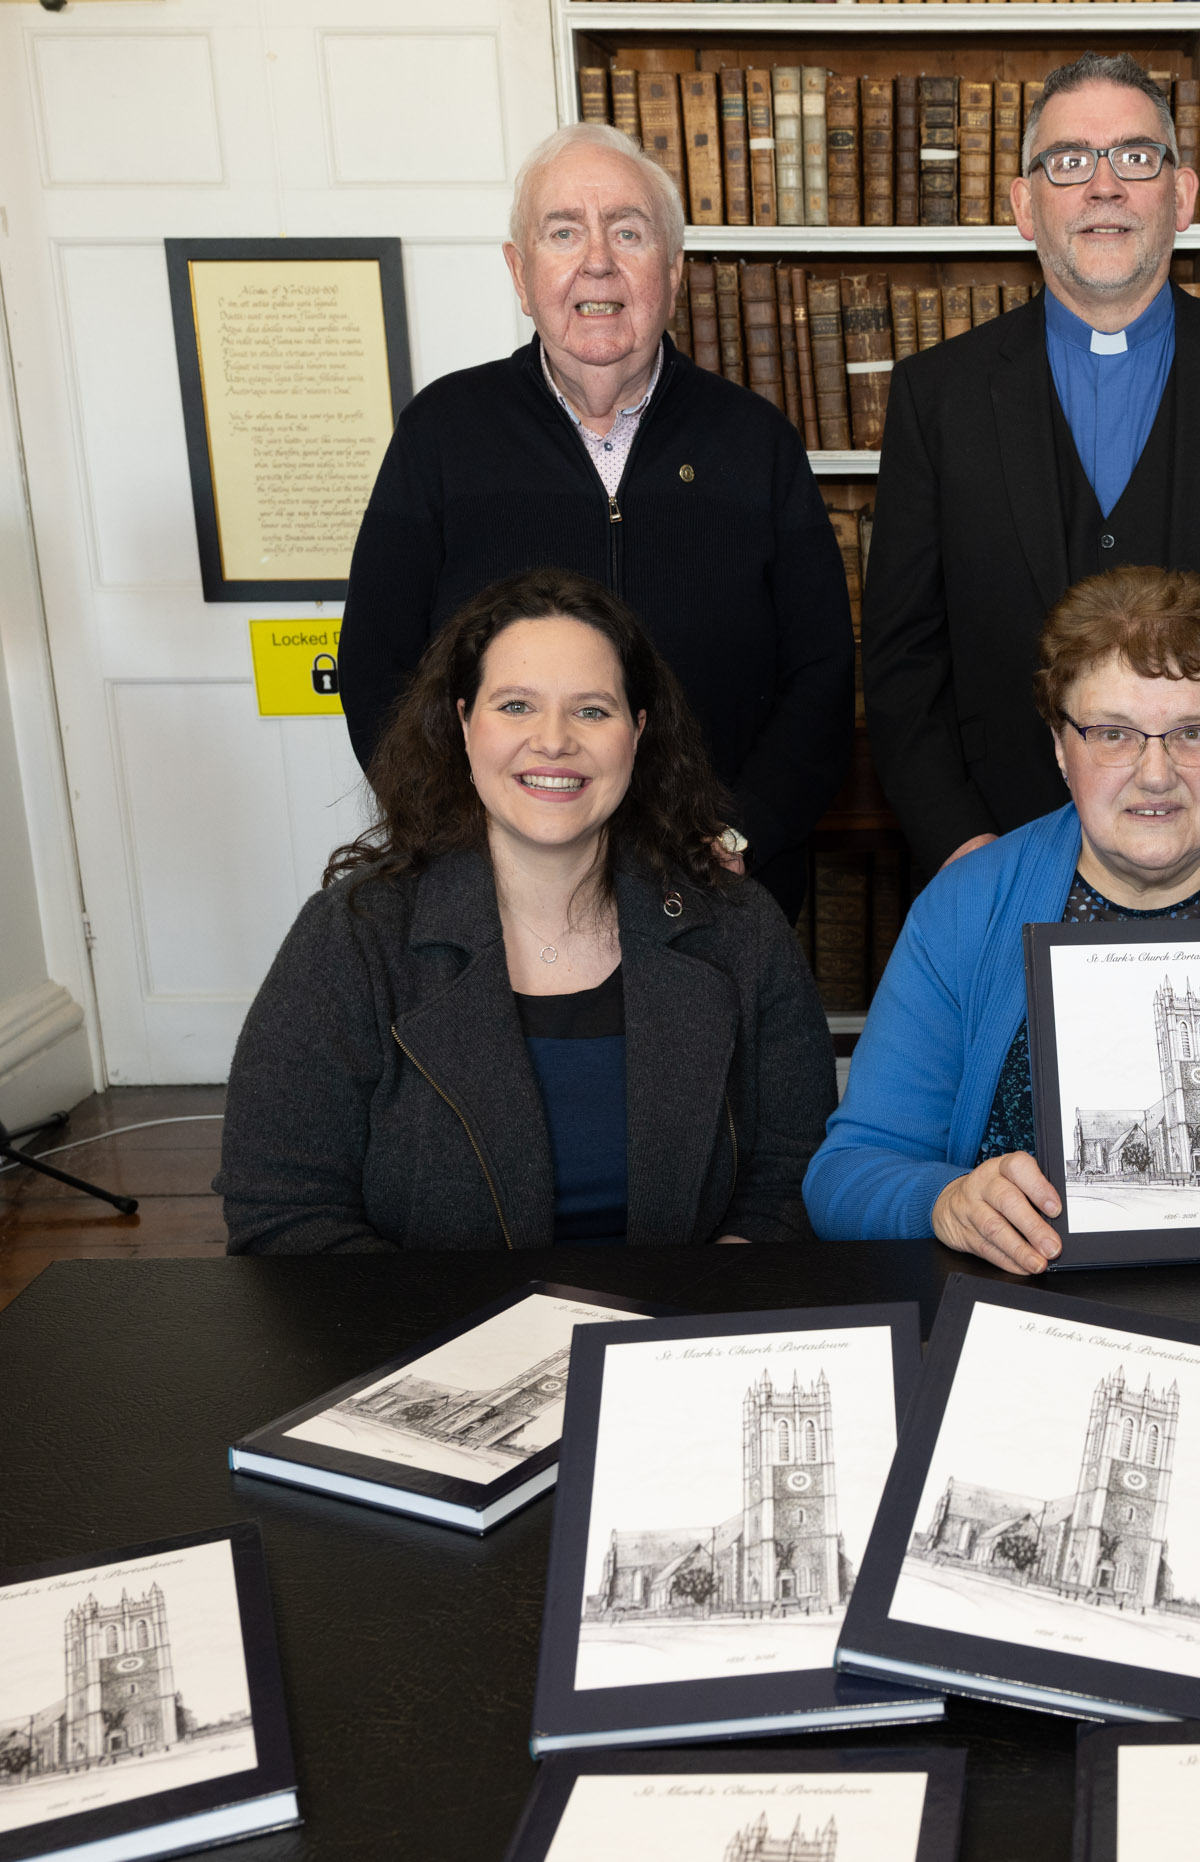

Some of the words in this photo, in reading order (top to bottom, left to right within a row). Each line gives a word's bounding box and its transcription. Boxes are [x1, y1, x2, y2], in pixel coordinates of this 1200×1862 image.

[272, 632, 328, 646] Locked
[1086, 953, 1099, 963] St
[1100, 952, 1135, 963] Mark's
[1137, 951, 1170, 962] Church
[1019, 1322, 1038, 1332] St
[1038, 1326, 1083, 1342] Mark's
[1088, 1336, 1132, 1351] Church
[655, 1350, 672, 1361] St
[676, 1347, 722, 1359] Mark's
[728, 1343, 772, 1356] Church
[776, 1340, 849, 1354] Portadown
[723, 1784, 778, 1797] Church
